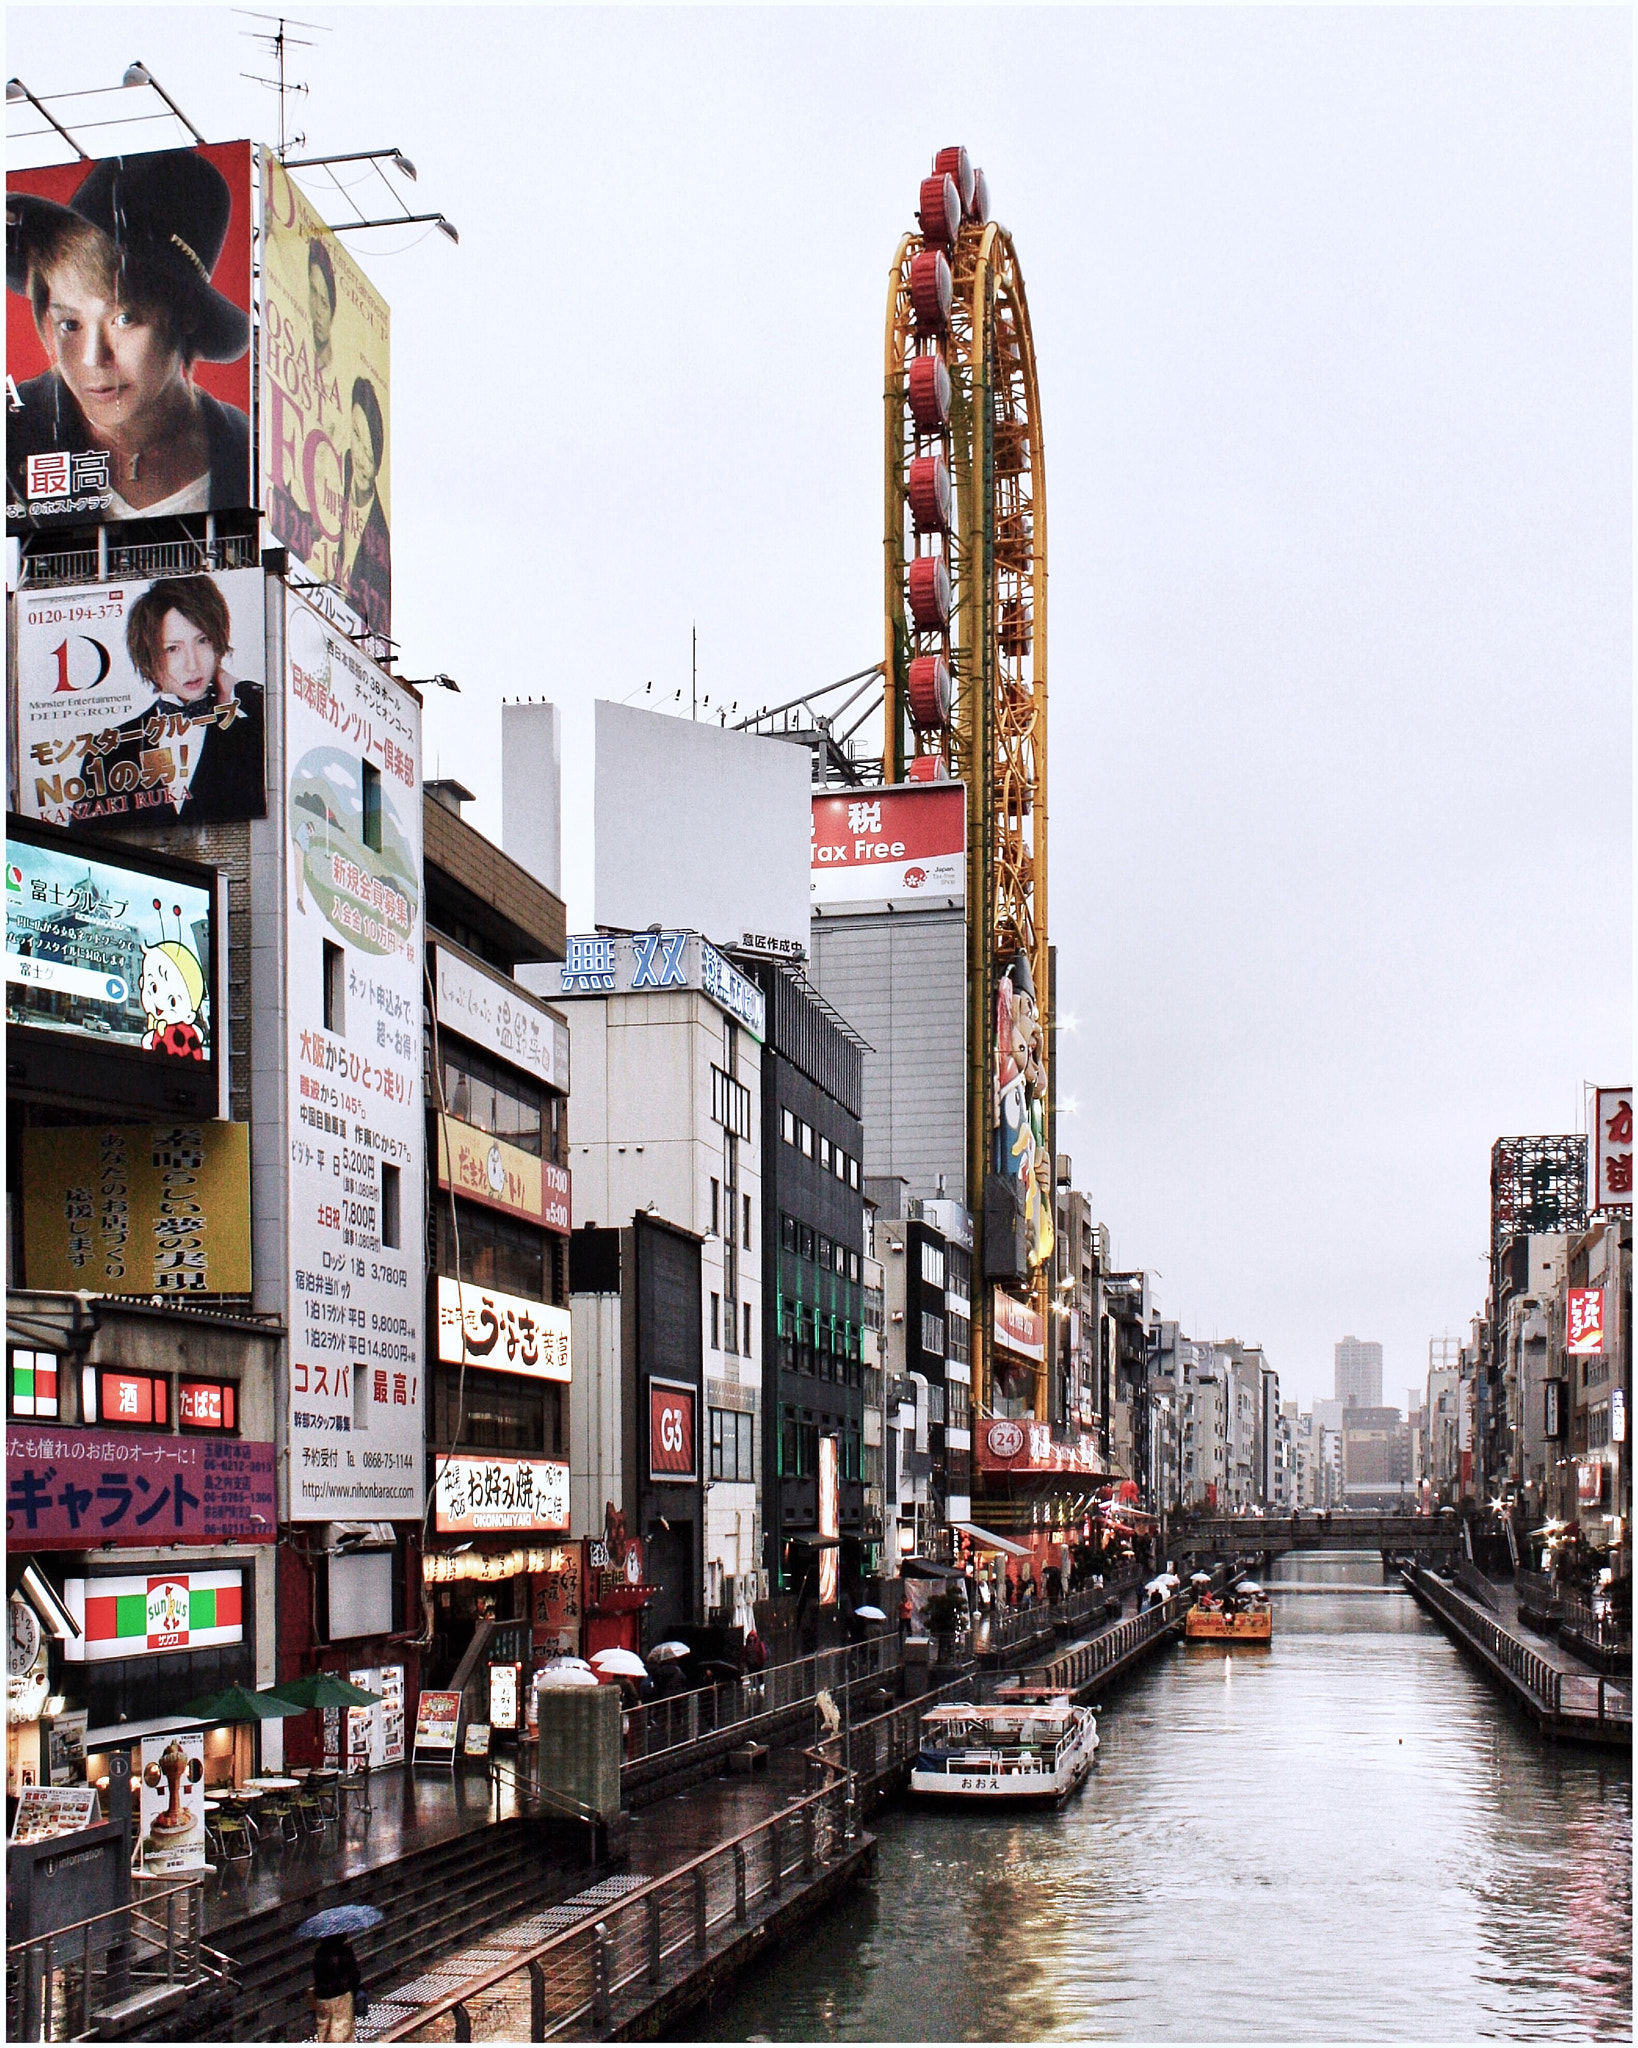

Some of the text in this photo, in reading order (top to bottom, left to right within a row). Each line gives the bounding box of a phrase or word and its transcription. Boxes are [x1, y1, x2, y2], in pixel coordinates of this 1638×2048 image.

[266, 299, 343, 415] OSAKA
[266, 331, 323, 425] HOST
[31, 450, 110, 494] 最高
[28, 603, 123, 625] 0120-194-373
[30, 693, 131, 709] Monster Entertainment
[30, 704, 133, 721] DEEP GROUP
[30, 699, 241, 766] モンスターグループ
[292, 664, 414, 789] 日本原カンツリー倶楽部
[40, 783, 194, 823] KANZAKI RUKA
[855, 840, 906, 859] Free
[31, 879, 129, 918] 富士グループ
[742, 933, 803, 952] 意匠作成中
[562, 933, 687, 990] 無双
[300, 1103, 347, 1140] 中国自動車道
[342, 1147, 375, 1180] 5,200円
[546, 1166, 568, 1194] 17:00
[101, 1133, 129, 1279] あなたのお店づくり
[317, 1199, 376, 1232] 土日祝 7,800円
[66, 1187, 95, 1268] 応援します
[351, 1258, 366, 1278] 1泊
[371, 1263, 408, 1288] 3,780円
[348, 1307, 366, 1329] 平日
[465, 1296, 540, 1367] うなぎ
[348, 1335, 366, 1356] 平日
[294, 1363, 349, 1398] コスパ
[119, 1382, 138, 1414] 酒
[180, 1390, 221, 1419] たばこ
[661, 1408, 682, 1453] G3
[996, 1433, 1016, 1446] 24
[302, 1447, 338, 1468] 予約受付
[6, 1466, 200, 1529] ギャラント
[468, 1465, 533, 1509] お好み焼
[472, 1513, 532, 1527] OKONOMIYAKI
[25, 1618, 32, 1629] 2
[27, 1631, 33, 1643] 3
[157, 1633, 179, 1646] サンクス
[12, 1658, 18, 1670] 6
[19, 1654, 25, 1665] 5
[961, 1778, 1000, 1789] おおえ
